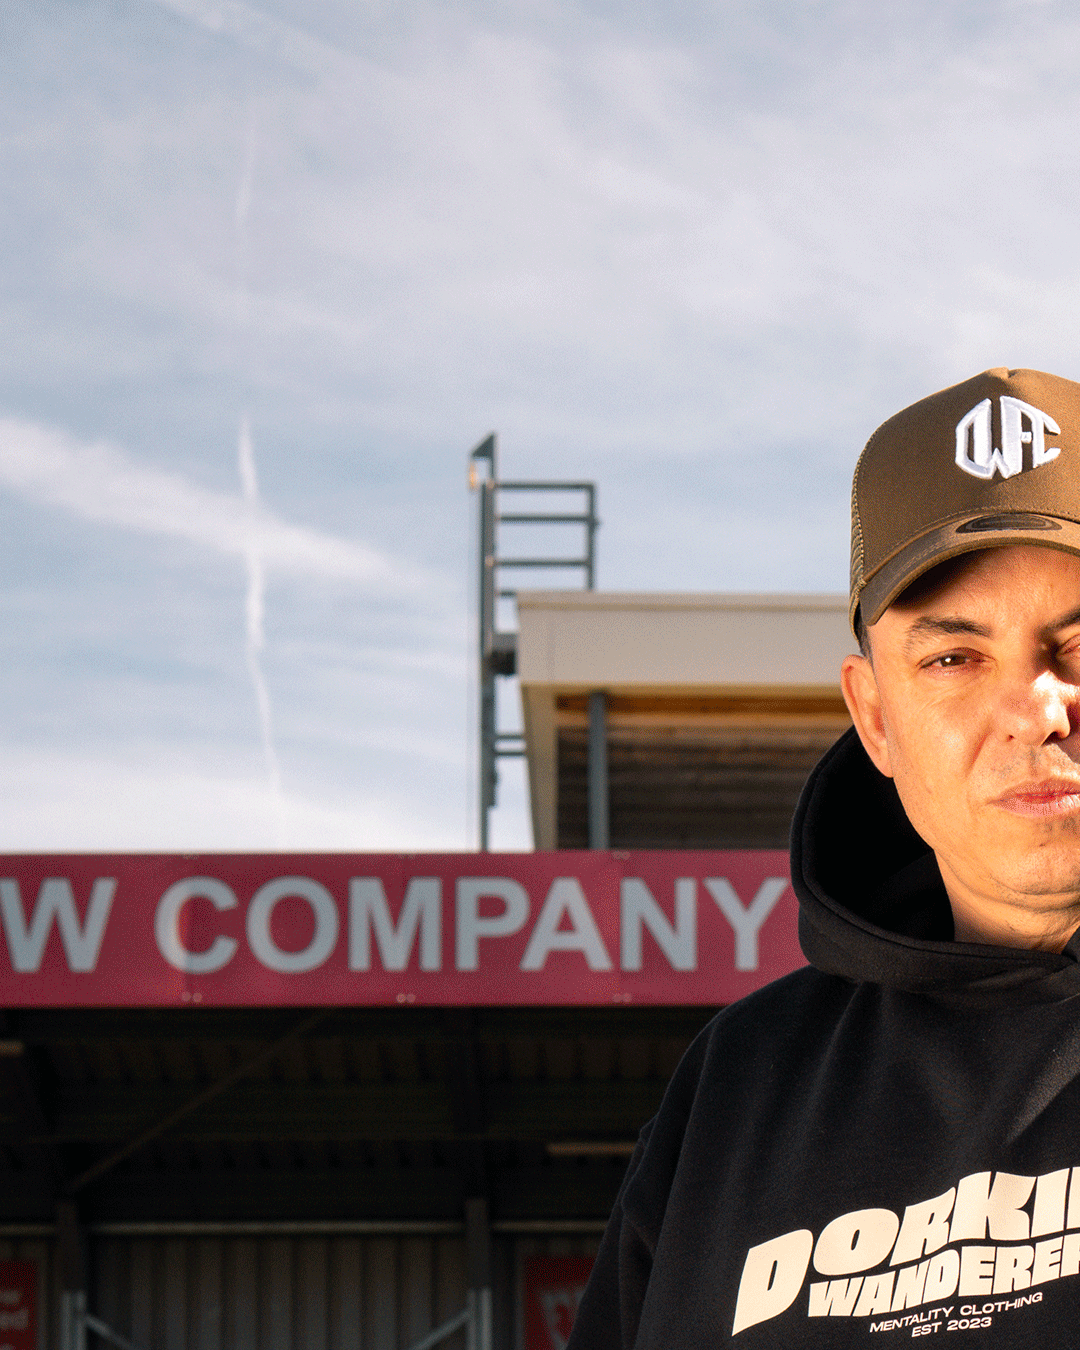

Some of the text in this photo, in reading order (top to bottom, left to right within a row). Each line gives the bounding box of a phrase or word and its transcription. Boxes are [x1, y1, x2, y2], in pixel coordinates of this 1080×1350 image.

[154, 876, 790, 975] COMPANY
[869, 1292, 1043, 1333] MENTALITY CLOTHING
[911, 1317, 992, 1337] EST 2023
